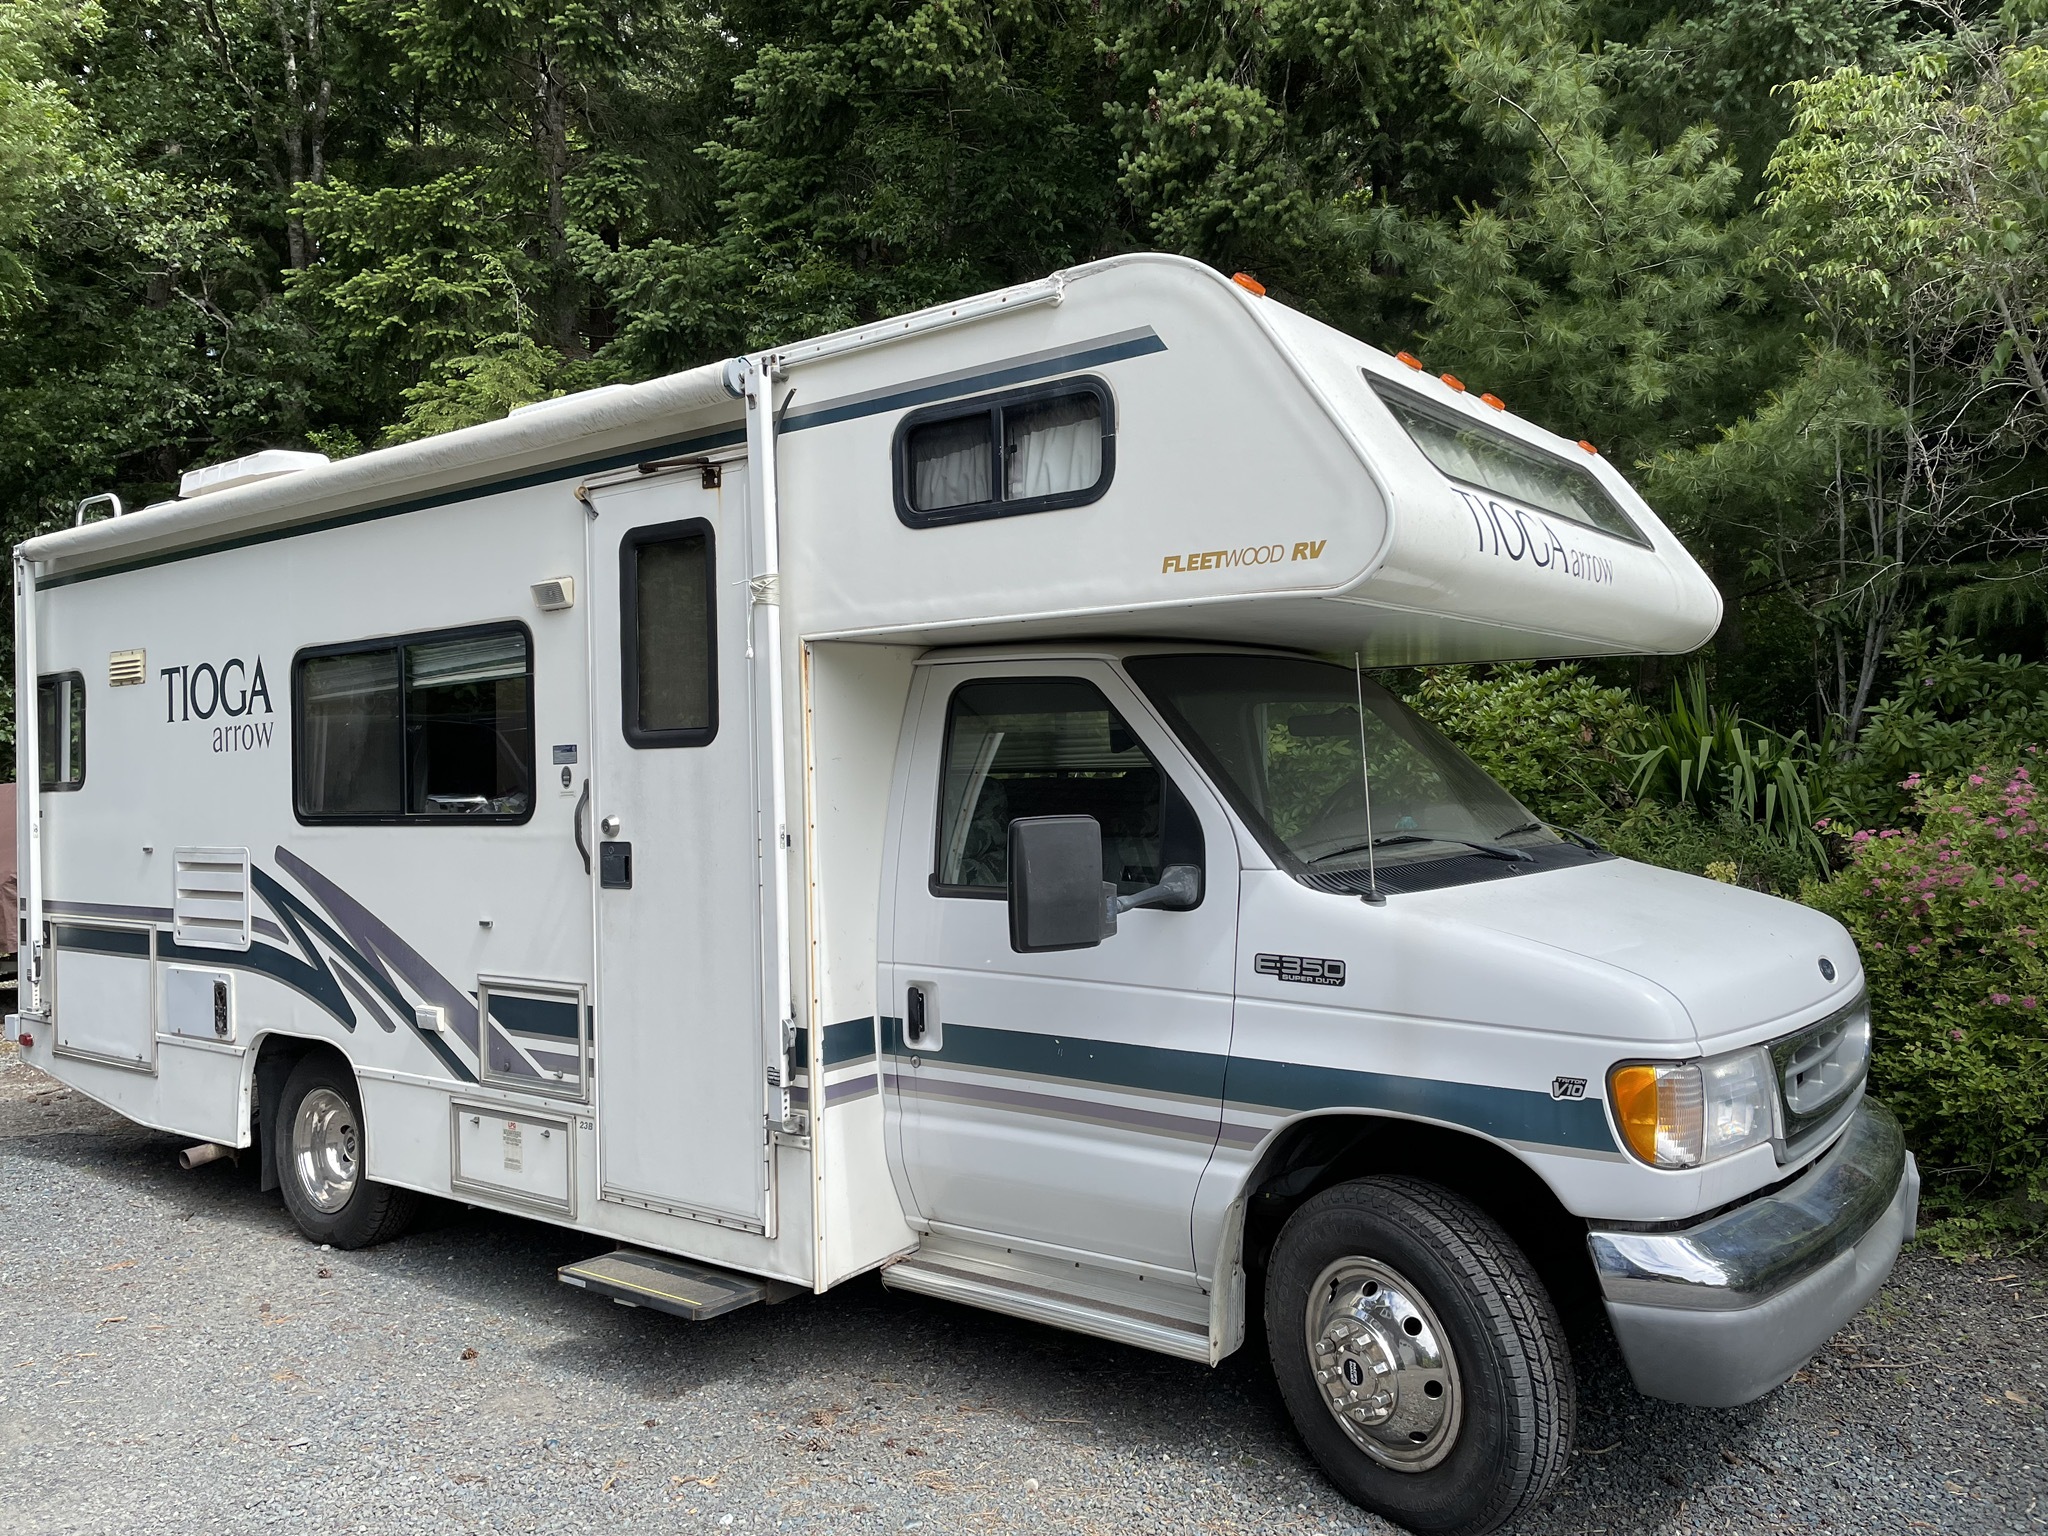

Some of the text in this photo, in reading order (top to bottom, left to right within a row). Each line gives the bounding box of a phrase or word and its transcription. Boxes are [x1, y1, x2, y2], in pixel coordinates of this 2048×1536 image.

[1450, 486, 1614, 587] TIOGA arrow
[1161, 539, 1328, 574] FLEETWOOD RV
[159, 653, 274, 723] TIOGA
[212, 721, 274, 753] arrow
[1281, 973, 1342, 985] SUPER DUTY
[1553, 1081, 1584, 1097] V10
[1557, 1077, 1586, 1085] TRITON
[579, 1120, 594, 1131] 23B
